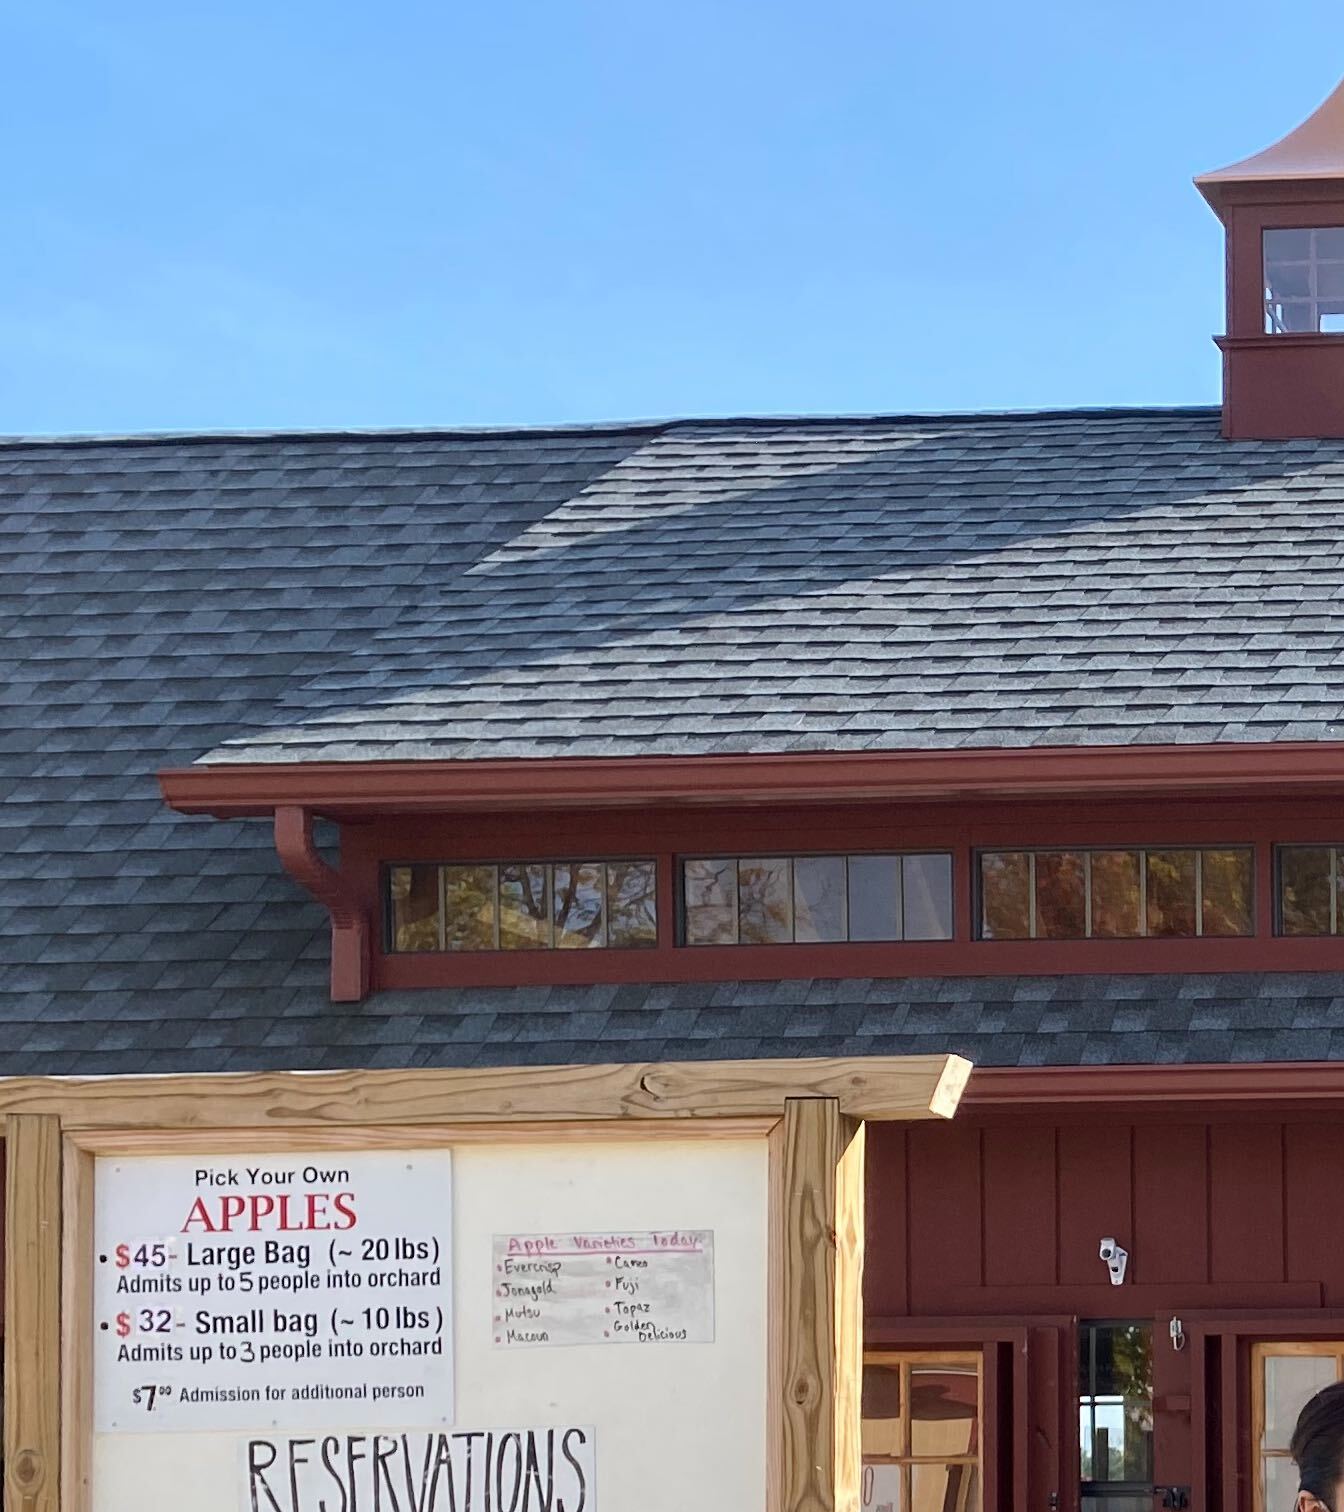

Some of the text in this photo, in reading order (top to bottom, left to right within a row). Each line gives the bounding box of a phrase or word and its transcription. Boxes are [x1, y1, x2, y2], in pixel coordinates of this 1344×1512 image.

[195, 1167, 349, 1186] Pick Your Own
[180, 1192, 358, 1233] APPLES
[187, 1242, 255, 1270] Large
[265, 1241, 311, 1267] Bag
[507, 1237, 558, 1256] Apple
[117, 1267, 441, 1294] Admits up to 5 people into orchard
[615, 1278, 639, 1295] Fuji
[196, 1309, 264, 1335] Small
[274, 1309, 318, 1337] bag
[117, 1343, 183, 1362] Admits
[190, 1346, 212, 1364] up
[219, 1343, 237, 1359] to
[260, 1341, 321, 1363] people
[328, 1339, 363, 1357] into
[370, 1337, 442, 1355] orchard
[180, 1386, 260, 1402] Admission
[265, 1386, 285, 1401] for
[292, 1384, 367, 1400] additional
[372, 1386, 425, 1401] person
